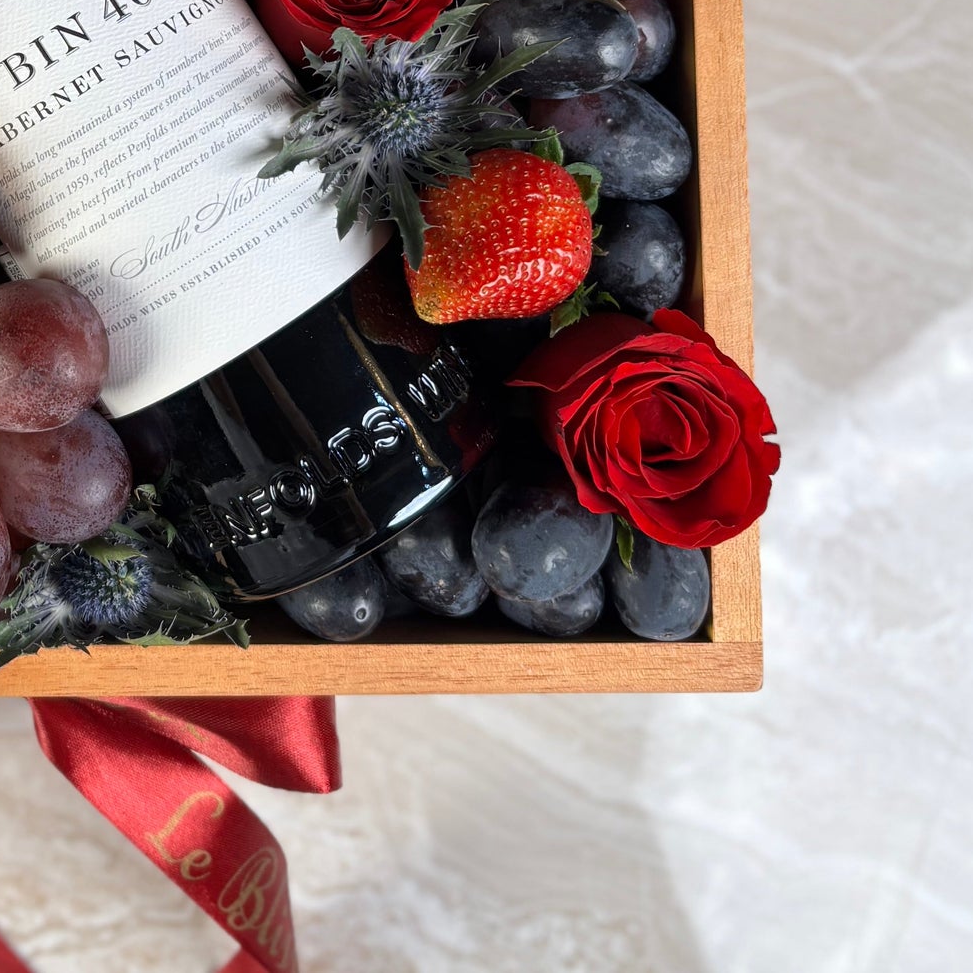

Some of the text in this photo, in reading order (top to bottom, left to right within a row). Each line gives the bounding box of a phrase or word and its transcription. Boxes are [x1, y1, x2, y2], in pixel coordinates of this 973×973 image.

[9, 181, 37, 208] Magill
[37, 168, 64, 187] where
[65, 156, 80, 171] the
[82, 138, 108, 165] finest
[109, 118, 139, 141] wines
[139, 103, 164, 121] were
[165, 81, 195, 106] stored.
[192, 71, 210, 85] The
[211, 46, 244, 75] renowned
[20, 158, 36, 173] has
[36, 147, 58, 163] long
[58, 107, 113, 149] maintained
[115, 104, 121, 113] a
[123, 83, 154, 109] system
[155, 71, 165, 88] of
[166, 44, 208, 80] numbered
[225, 30, 232, 41] in
[27, 233, 34, 248] of
[34, 217, 68, 241] sourcing
[67, 208, 80, 221] the
[83, 195, 100, 212] best
[101, 178, 125, 204] fruit
[126, 163, 152, 189] from
[153, 133, 198, 171] premium
[199, 102, 245, 136] vineyards,
[243, 94, 253, 106] in
[252, 83, 269, 102] order
[28, 196, 55, 221] created
[55, 190, 66, 203] in
[66, 173, 94, 195] 1959,
[94, 152, 127, 178] reflects
[127, 124, 168, 156] Penfolds
[170, 94, 215, 129] meticulous
[215, 63, 259, 97] winemaking
[36, 248, 53, 263] both
[53, 226, 87, 255] regional
[89, 214, 107, 233] and
[108, 188, 148, 220] varietal
[150, 159, 199, 195] characters
[200, 150, 209, 162] to
[211, 138, 225, 155] the
[227, 111, 267, 143] distinctive
[110, 216, 191, 279] South
[88, 286, 104, 300] 90
[105, 192, 321, 336] FOLDS WINES ESTABLISHED 1844 SOUTH
[190, 405, 404, 548] ENFOLDS
[145, 791, 224, 880] Le
